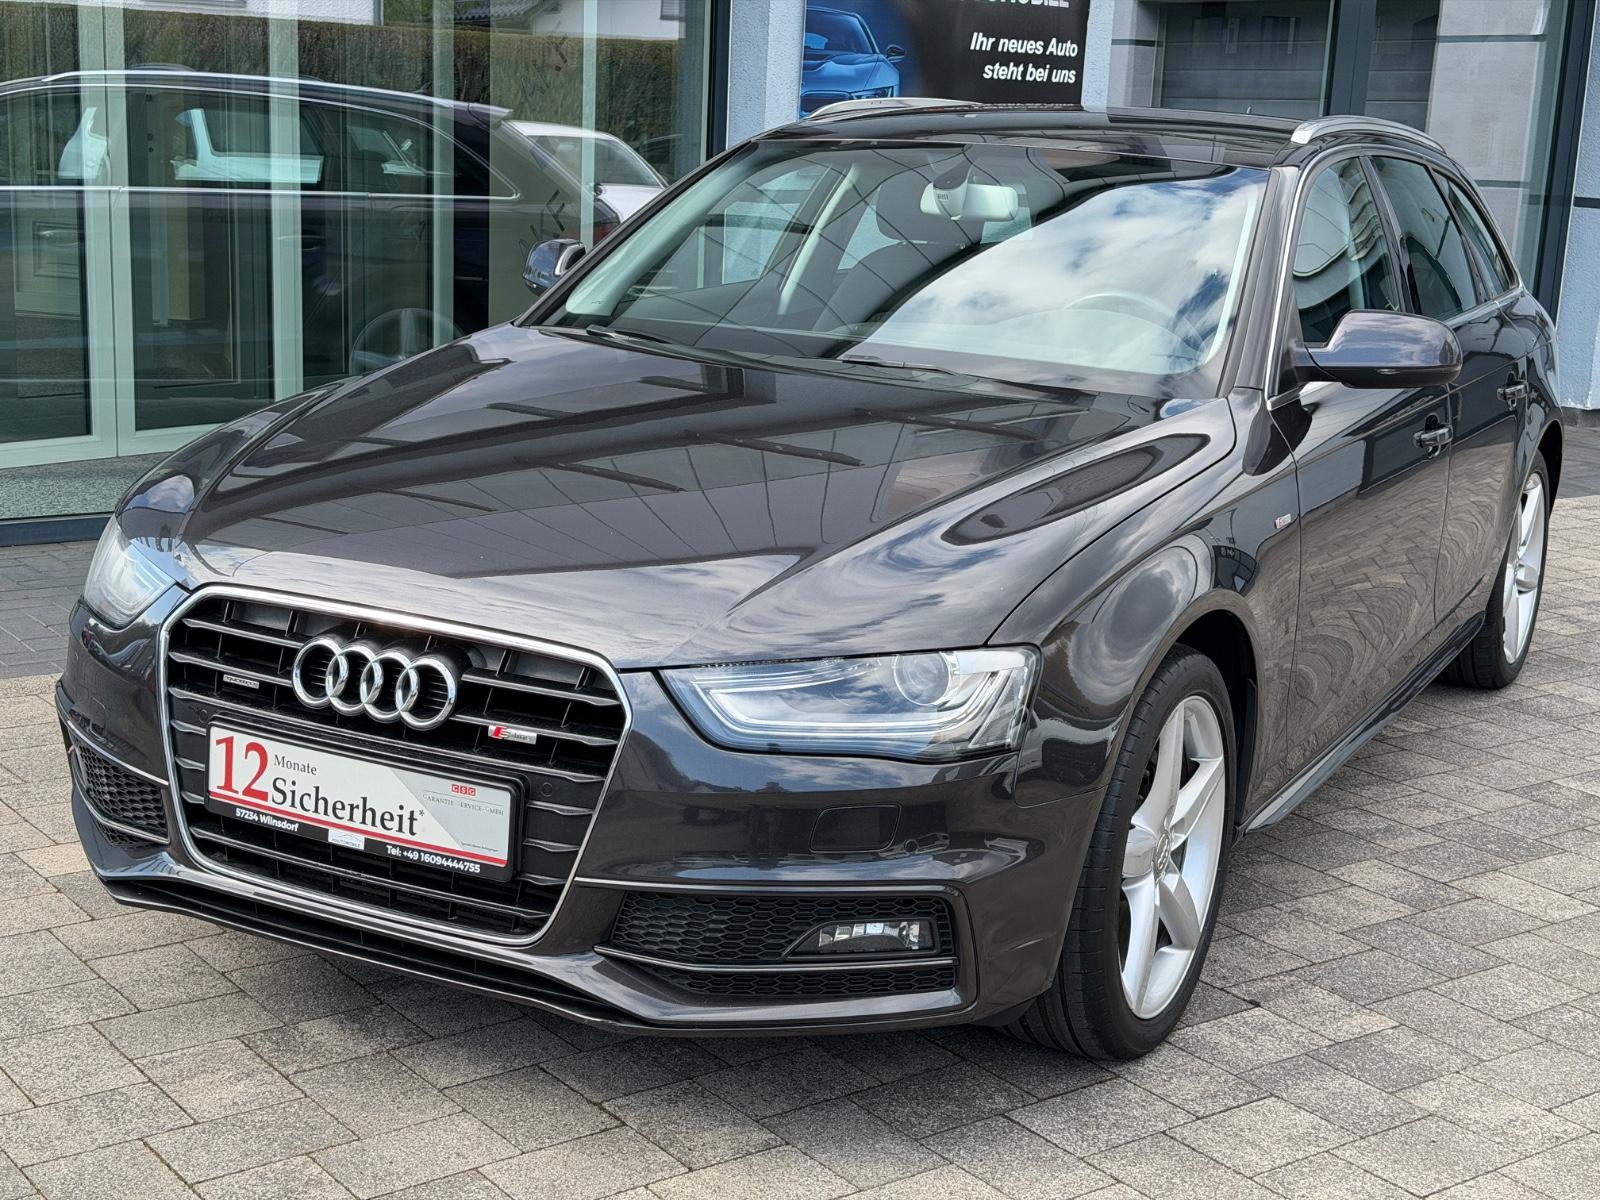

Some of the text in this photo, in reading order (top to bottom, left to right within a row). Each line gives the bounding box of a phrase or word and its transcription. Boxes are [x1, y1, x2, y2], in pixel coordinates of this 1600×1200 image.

[970, 32, 1078, 57] Ihr neues Auto
[983, 62, 1077, 83] steht bei uns
[215, 736, 269, 802] 12
[274, 754, 317, 776] Monate
[452, 784, 476, 796] GSG
[235, 808, 299, 832] 57234 Wilnsdorf
[386, 845, 480, 873] Tel: +49 16094444755
